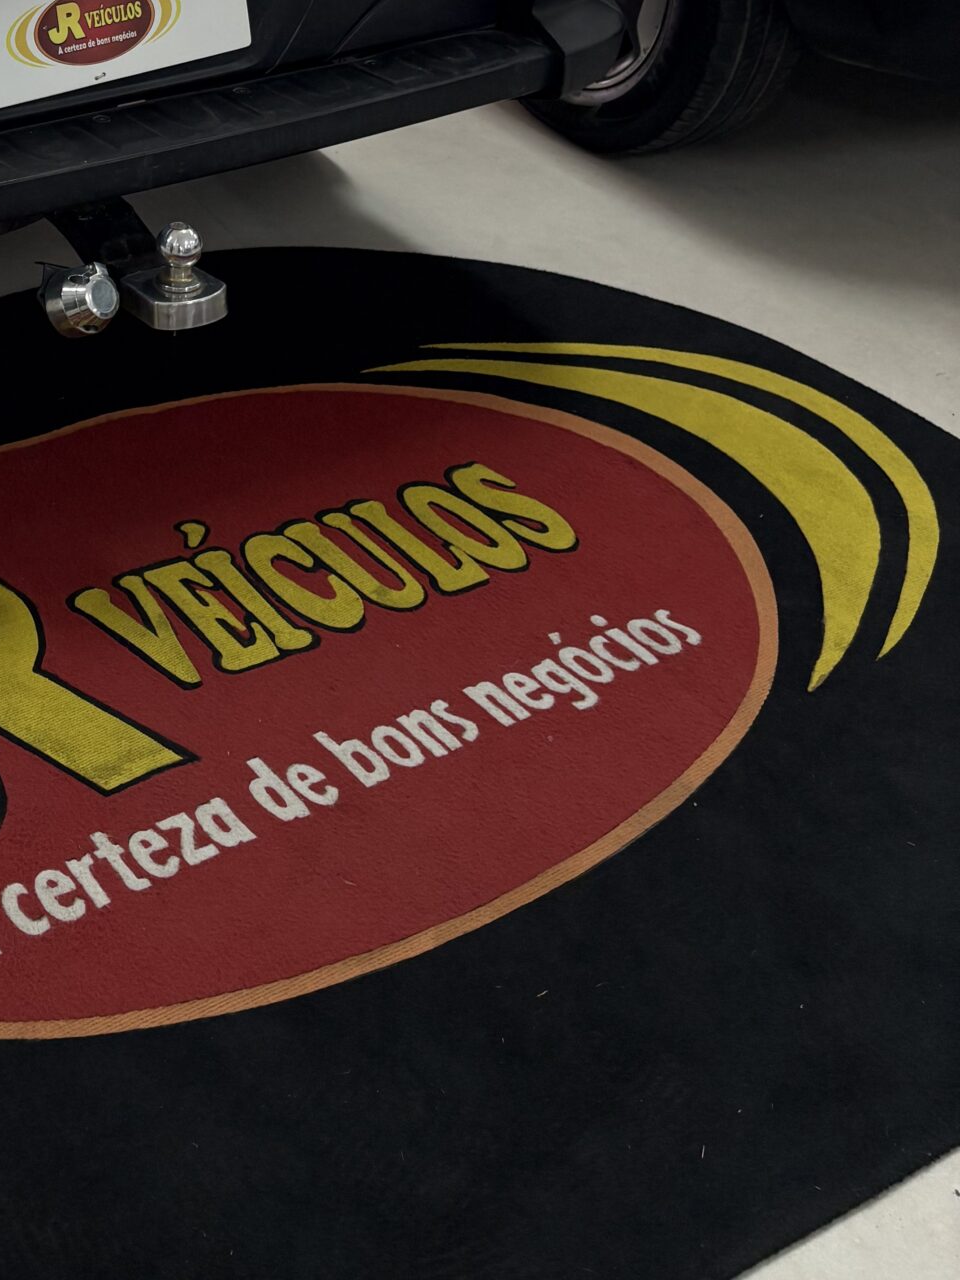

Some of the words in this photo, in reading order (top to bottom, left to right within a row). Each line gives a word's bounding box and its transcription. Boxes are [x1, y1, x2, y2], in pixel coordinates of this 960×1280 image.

[47, 1, 86, 45] JR
[84, 0, 143, 29] VEÍCULOS
[58, 46, 64, 55] A
[64, 43, 87, 54] certeza
[88, 39, 96, 48] de
[96, 37, 111, 46] bons
[111, 30, 137, 42] negócios
[66, 461, 580, 690] VEÍCULOS
[1, 797, 258, 936] certeza
[246, 756, 339, 822] de
[312, 696, 480, 789] bons
[462, 608, 703, 728] negócios
